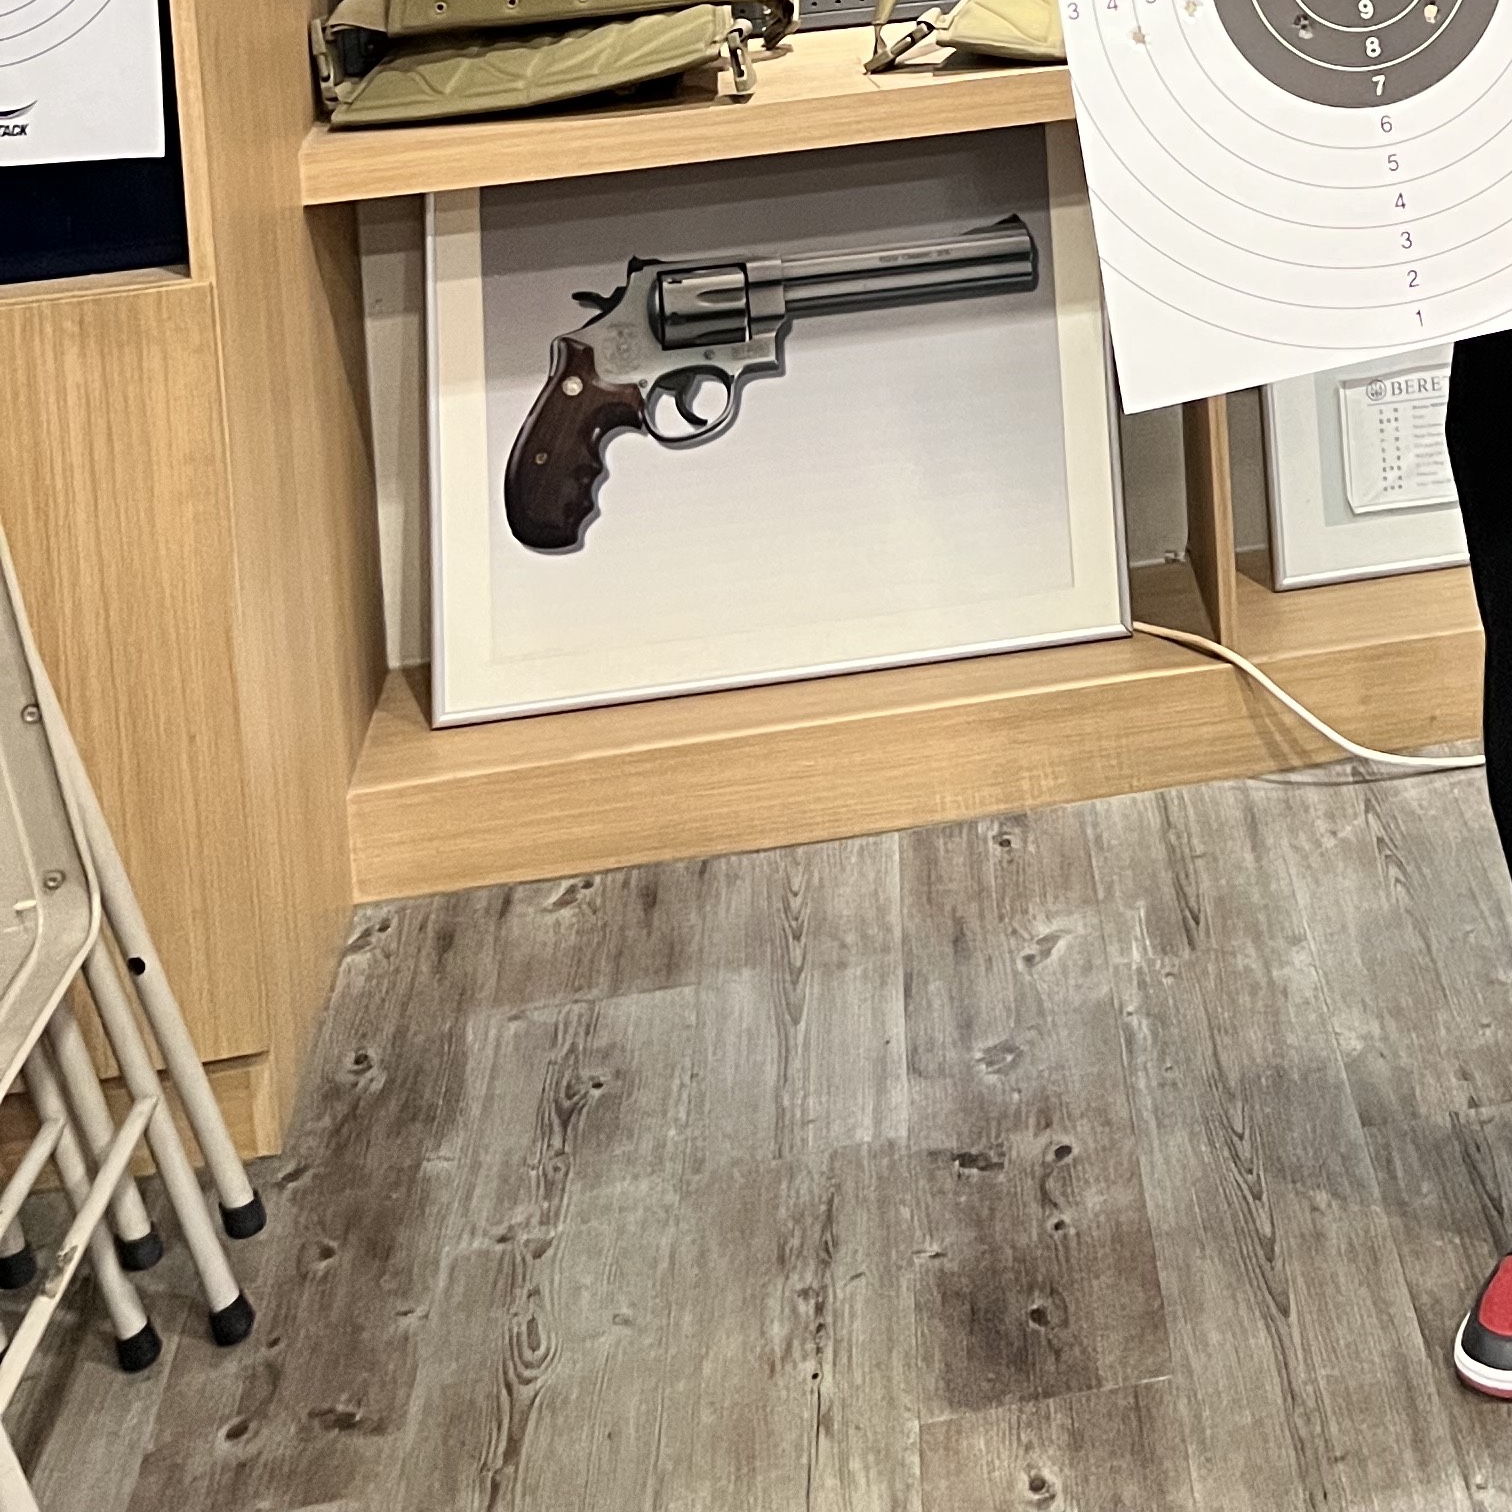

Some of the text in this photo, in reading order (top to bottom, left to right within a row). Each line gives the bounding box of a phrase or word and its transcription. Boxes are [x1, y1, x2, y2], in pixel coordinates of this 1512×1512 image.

[1068, 3, 1079, 20] 3
[1365, 36, 1381, 58] 8
[1372, 73, 1386, 95] 7
[1381, 115, 1392, 132] 6
[1388, 154, 1399, 171] 5
[1395, 193, 1406, 209] 4
[1401, 232, 1412, 249] 3
[1407, 270, 1419, 287] 2
[1416, 310, 1424, 327] 1
[1391, 376, 1450, 396] BERE
